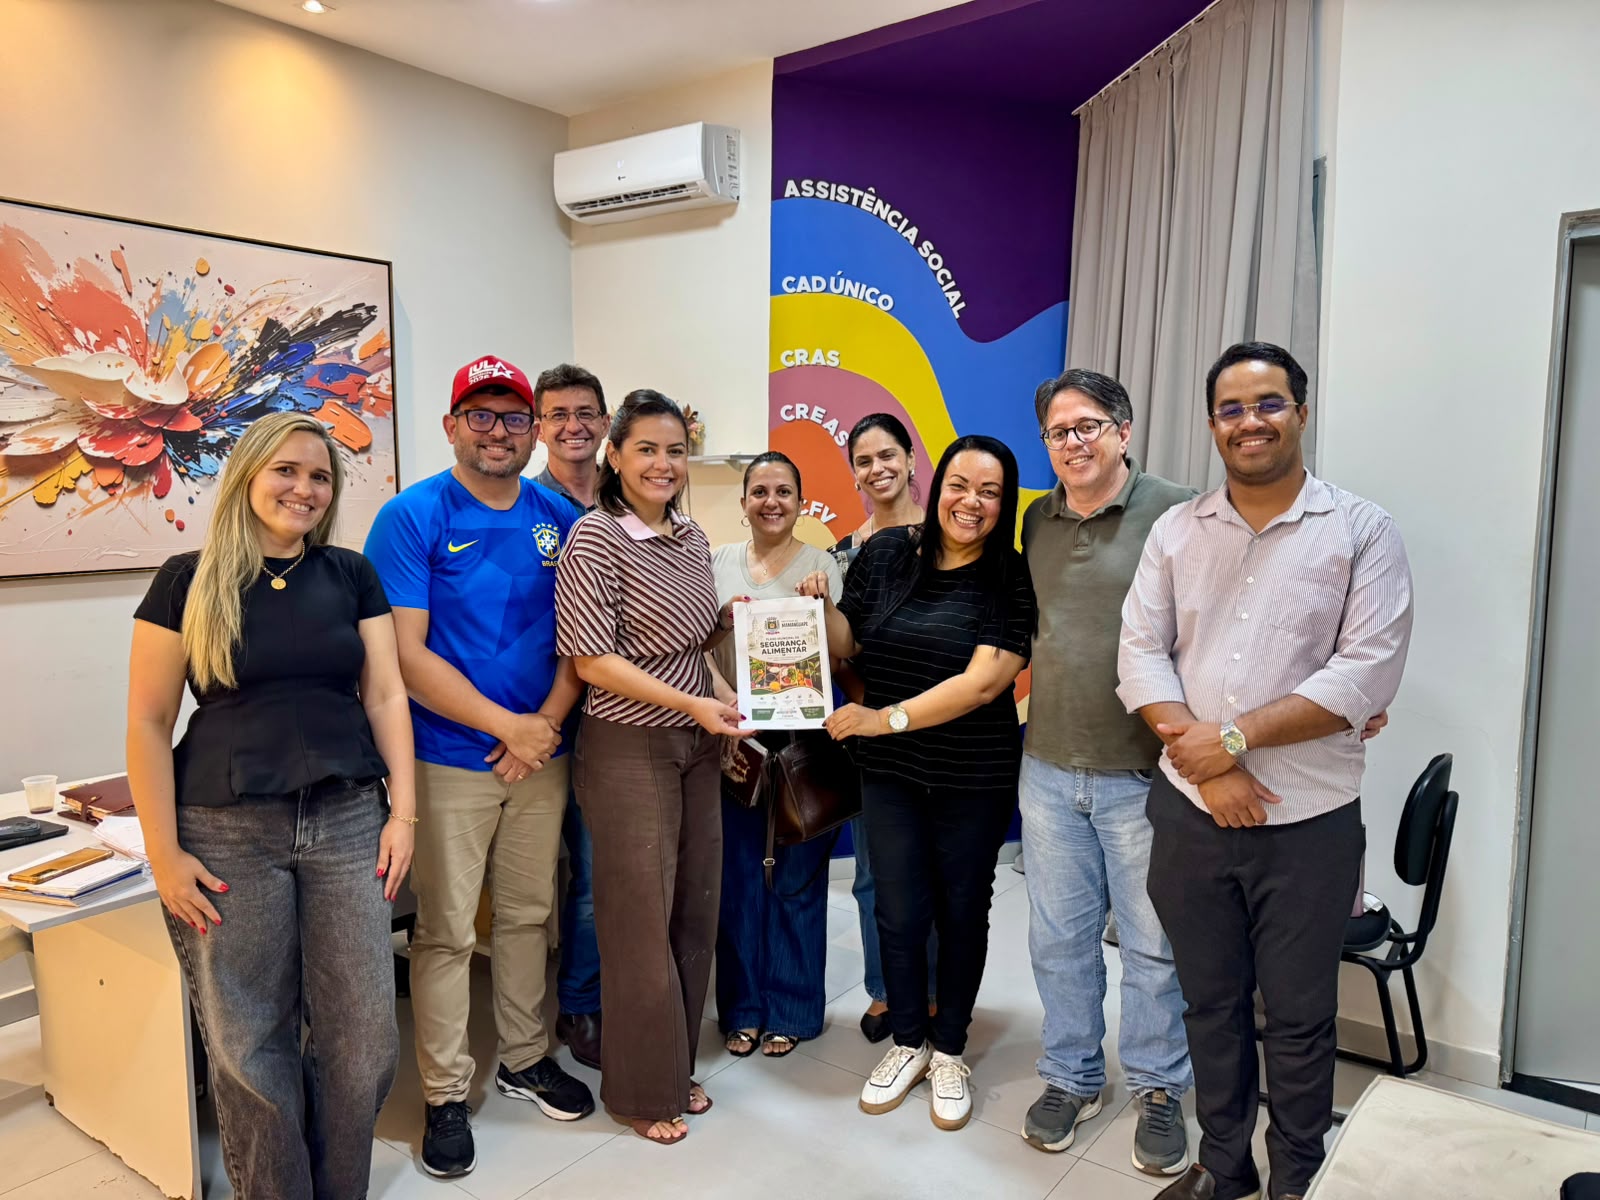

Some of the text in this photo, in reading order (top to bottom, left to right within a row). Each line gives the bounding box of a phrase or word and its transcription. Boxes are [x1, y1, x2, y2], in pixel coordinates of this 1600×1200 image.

[784, 179, 967, 319] ASSISTÊNCIA SOCIAL
[781, 270, 894, 312] CAD ÚNICO
[780, 348, 841, 368] CRAS
[780, 402, 849, 447] CREAS
[760, 640, 806, 648] SEGURANÇA
[762, 646, 807, 654] ALIMENTAR
